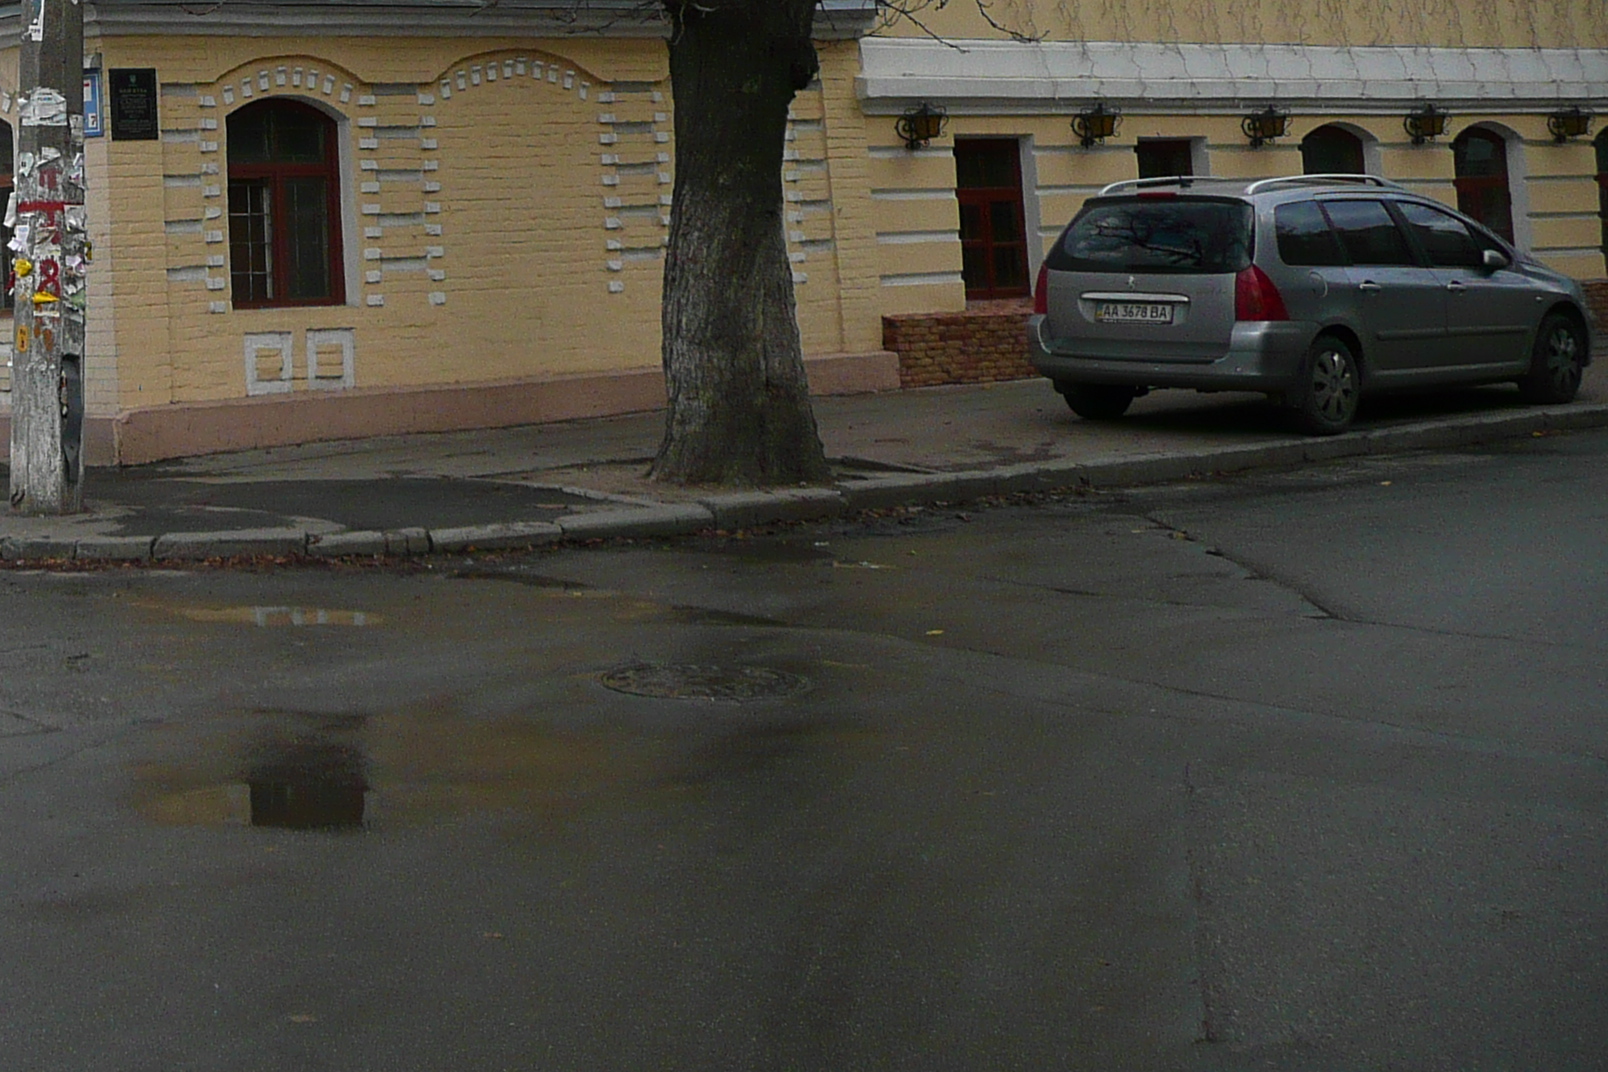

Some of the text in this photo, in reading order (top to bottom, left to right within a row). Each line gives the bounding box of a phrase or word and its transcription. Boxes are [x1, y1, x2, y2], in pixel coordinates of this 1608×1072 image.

[1102, 304, 1167, 318] AA 3678 BA
